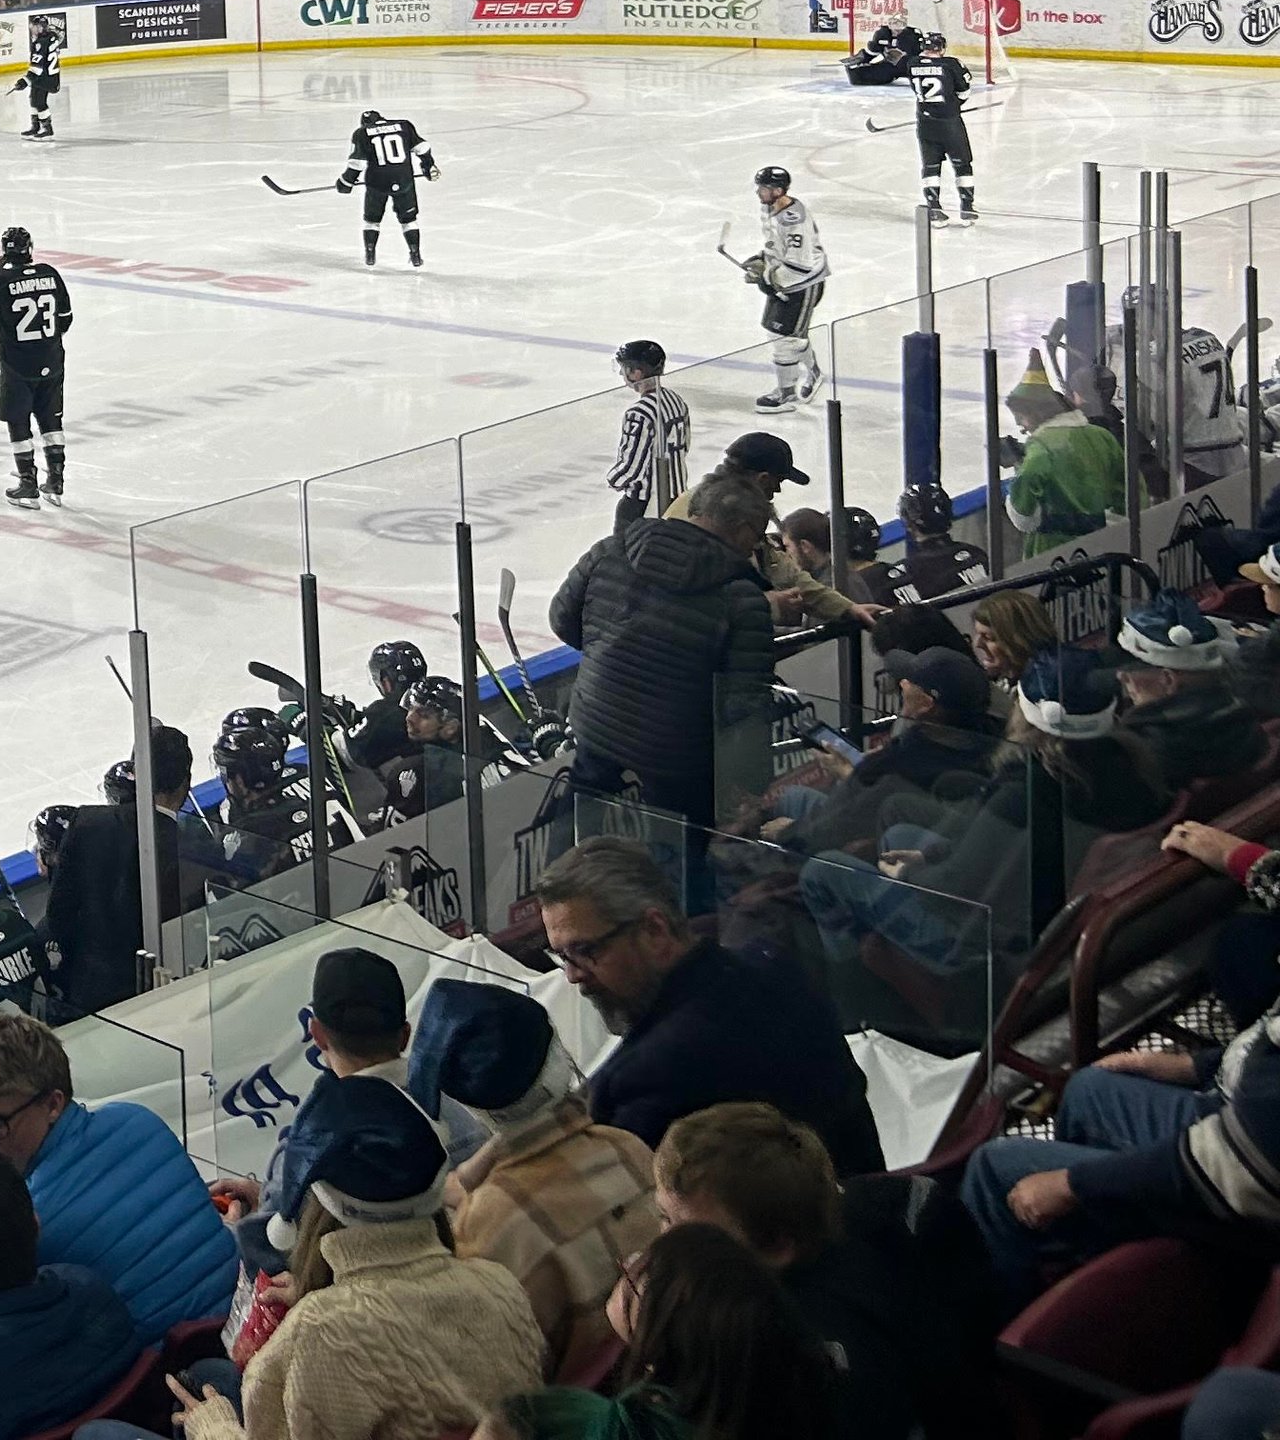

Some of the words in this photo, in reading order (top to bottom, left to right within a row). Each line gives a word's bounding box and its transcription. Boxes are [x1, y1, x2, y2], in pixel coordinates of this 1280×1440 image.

[118, 3, 201, 19] SCANDINAVIAN
[375, 3, 431, 13] WESTERN
[623, 4, 742, 20] RUTLEDGE
[135, 14, 185, 28] DESIGNS
[375, 13, 431, 24] IDAHO
[477, 21, 568, 29] TECHNOLOGY
[1026, 9, 1040, 23] in
[1043, 9, 1069, 23] the
[1072, 10, 1104, 25] box
[623, 20, 760, 31] INSURANCE
[131, 28, 189, 40] FURNITURE
[911, 76, 945, 103] 12
[369, 134, 407, 167] 10
[9, 275, 57, 296] CAMPAGNA
[11, 294, 57, 342] 23
